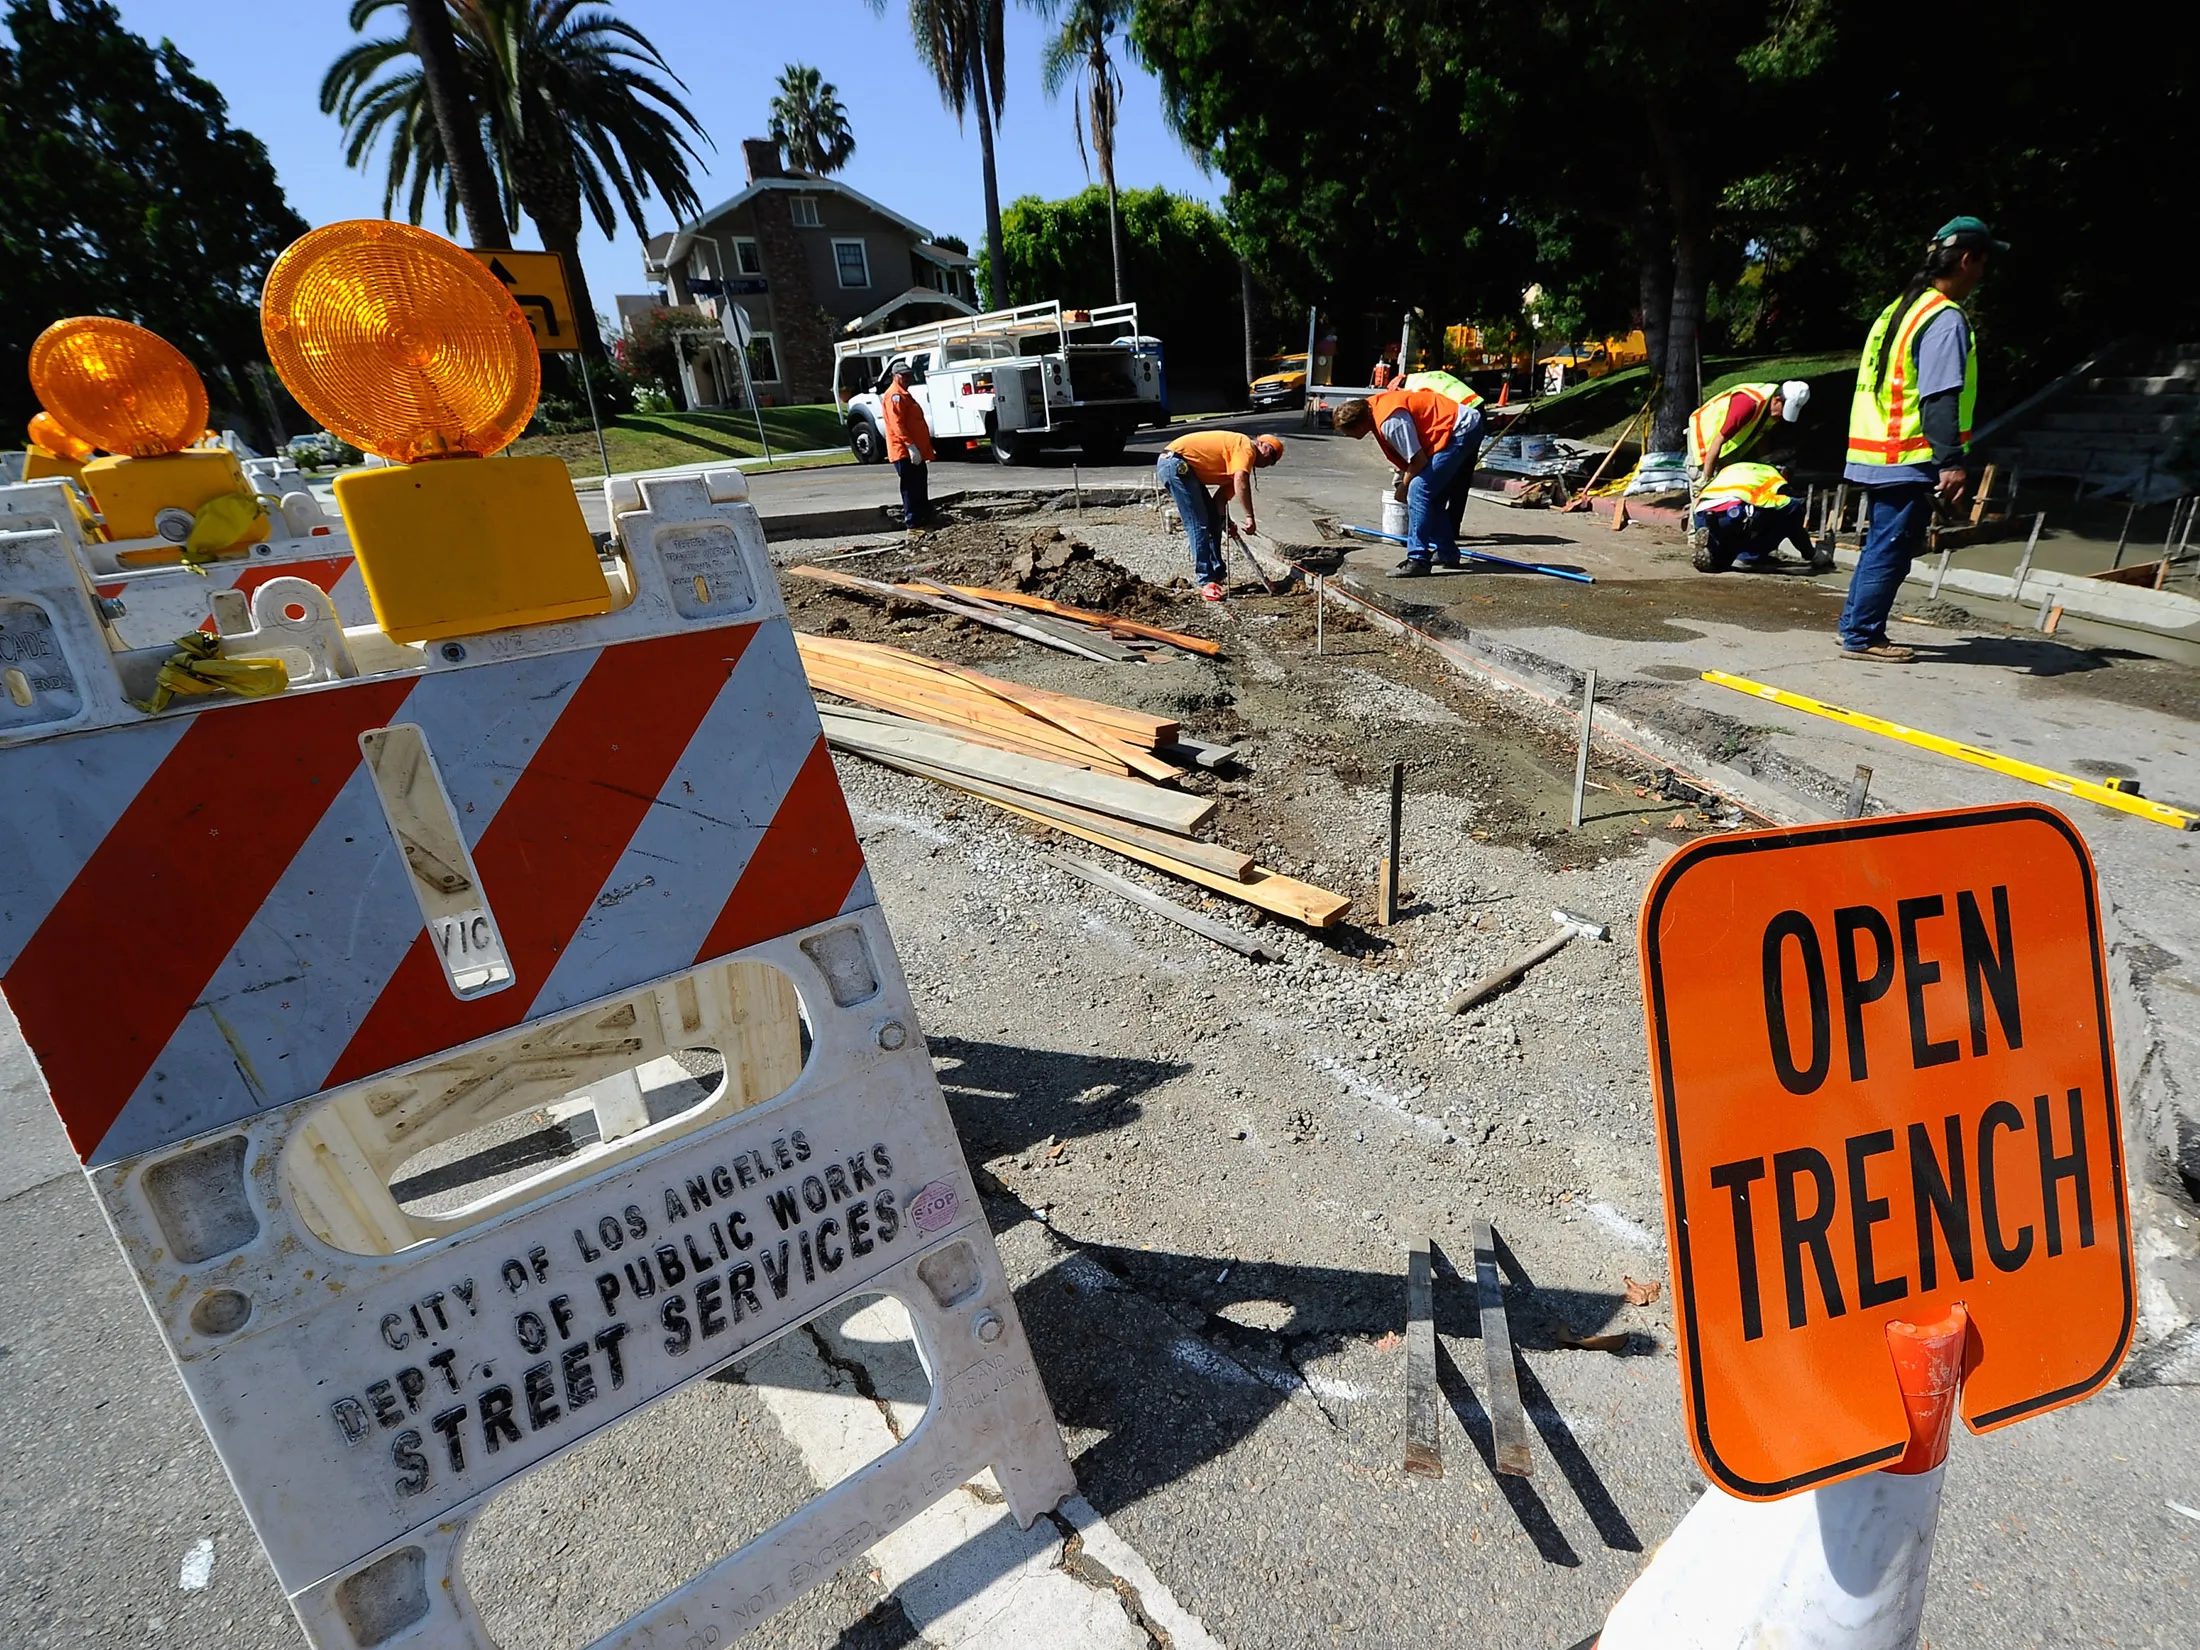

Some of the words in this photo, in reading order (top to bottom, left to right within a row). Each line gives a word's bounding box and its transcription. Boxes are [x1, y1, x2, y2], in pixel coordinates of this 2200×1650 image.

[1762, 885, 2023, 1095] OPEN
[380, 1278, 476, 1350] CITY
[502, 1246, 549, 1294] OF
[574, 1205, 649, 1264] LOS
[664, 1130, 811, 1224] ANGELES
[515, 1294, 573, 1354] OF
[595, 1211, 754, 1317] PUBLIC
[766, 1142, 894, 1231] WORKS
[914, 1192, 955, 1221] STOP
[1711, 1088, 2095, 1341] TRENCH
[391, 1323, 627, 1497] STREET
[661, 1189, 900, 1357] SERVICES
[730, 1582, 777, 1626] NOT
[787, 1520, 876, 1587] EXCEED
